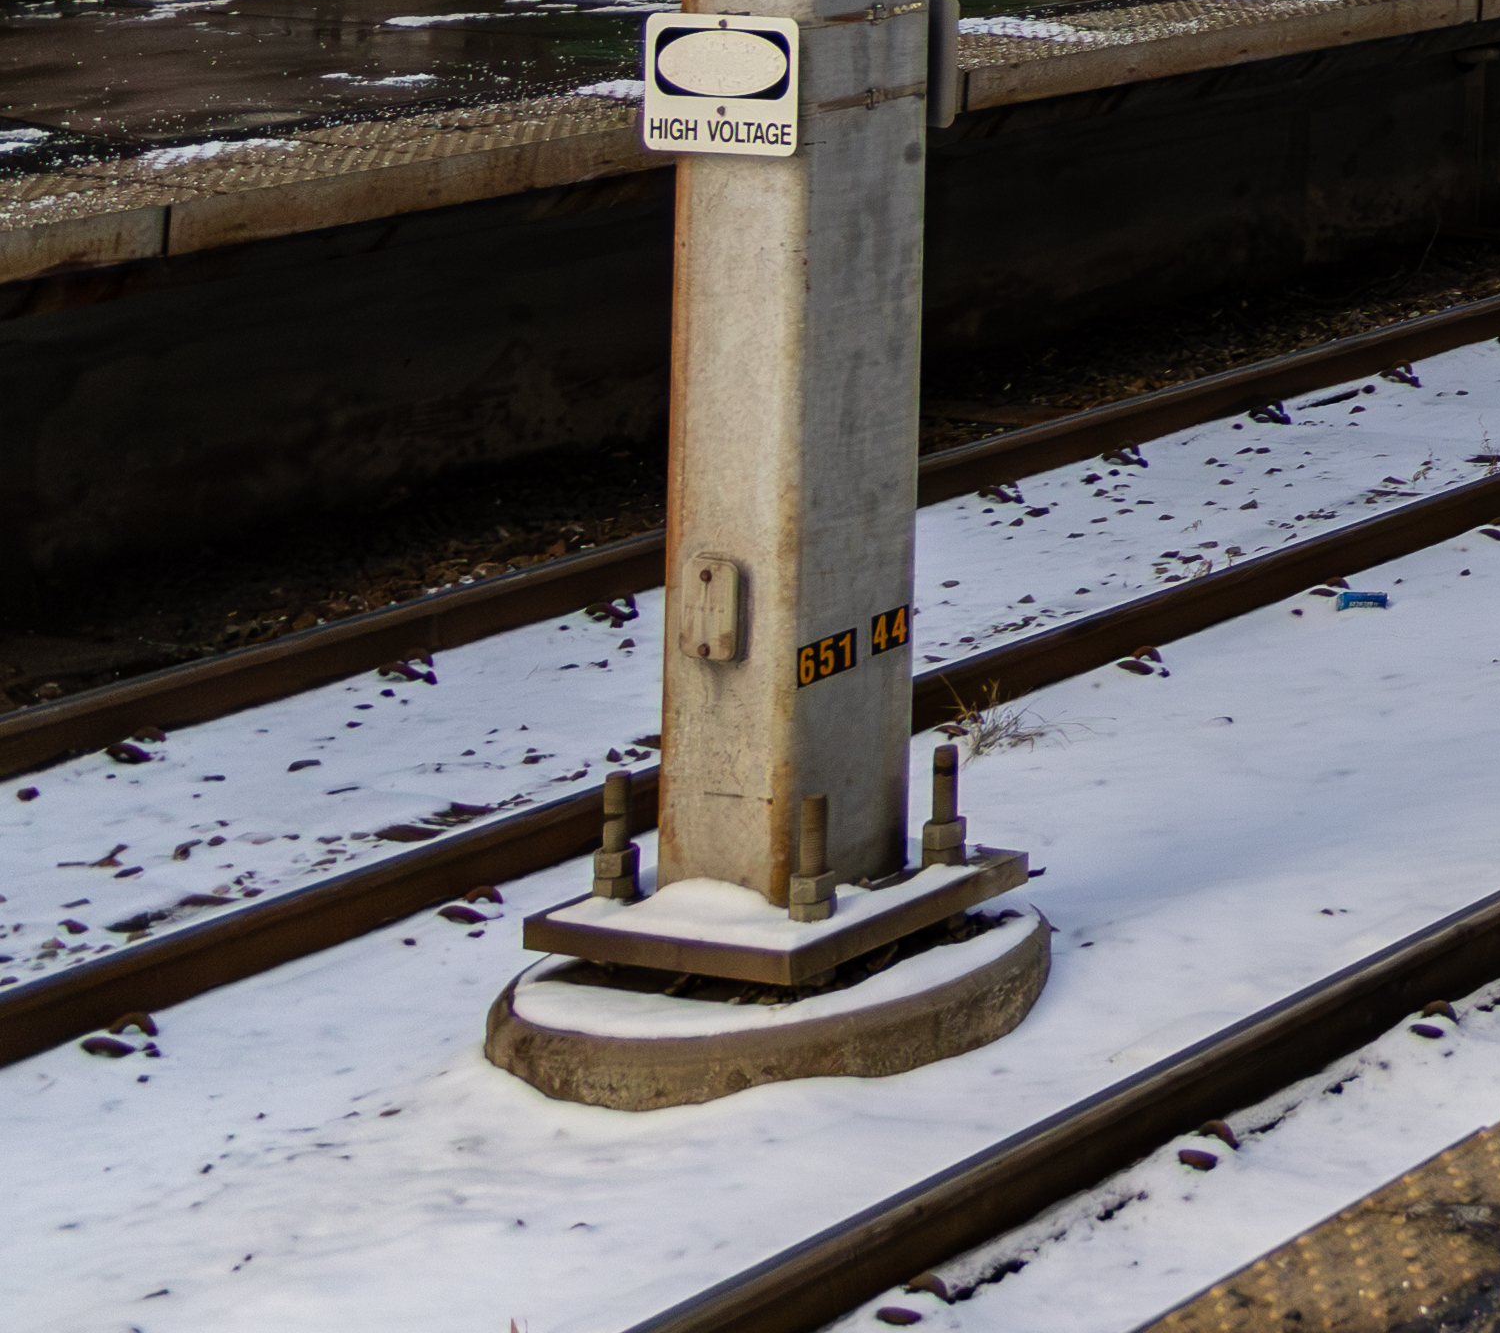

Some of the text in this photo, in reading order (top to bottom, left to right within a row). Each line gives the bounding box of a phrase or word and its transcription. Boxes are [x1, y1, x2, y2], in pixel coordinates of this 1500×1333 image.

[650, 117, 792, 146] HIGH VOLTAGE
[799, 607, 907, 684] 651 44
